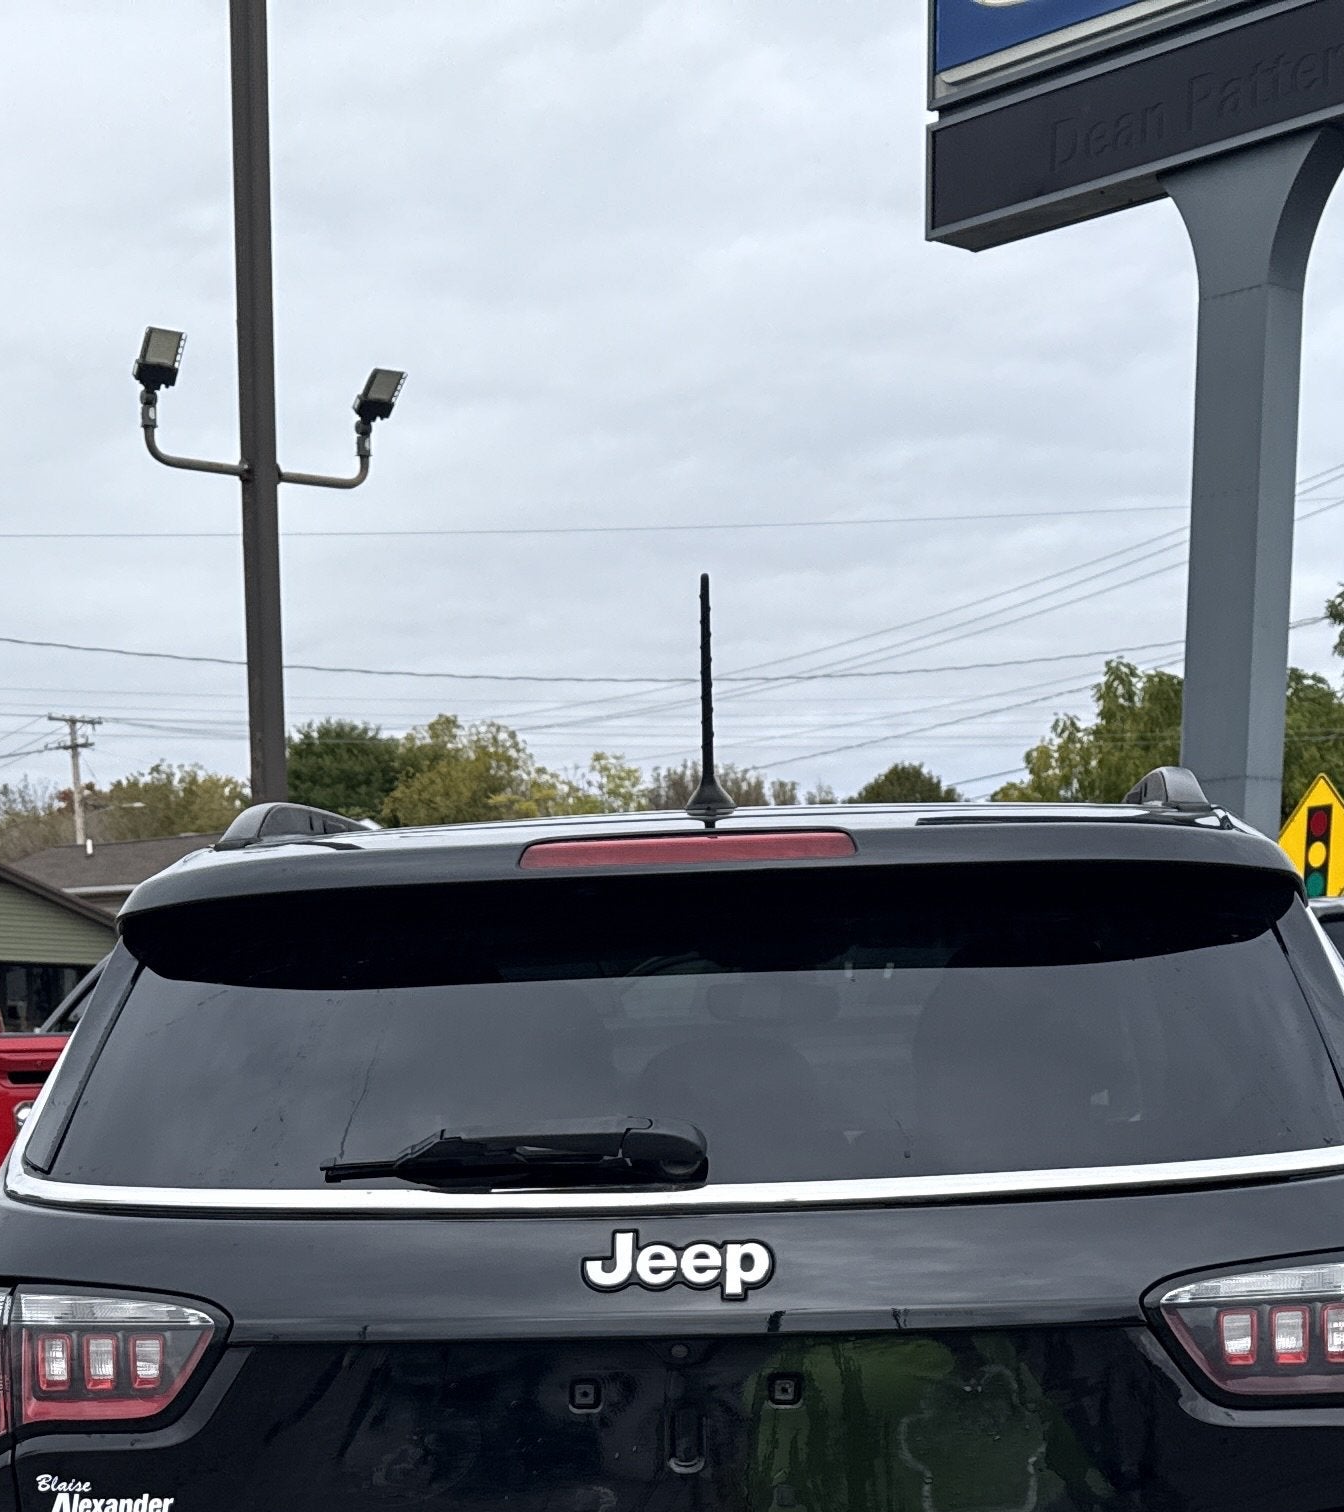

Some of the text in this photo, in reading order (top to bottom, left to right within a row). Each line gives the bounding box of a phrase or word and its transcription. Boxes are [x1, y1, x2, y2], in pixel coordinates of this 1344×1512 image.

[1049, 100, 1169, 174] Dean
[583, 1230, 773, 1299] Jeep
[36, 1474, 92, 1492] Blaise
